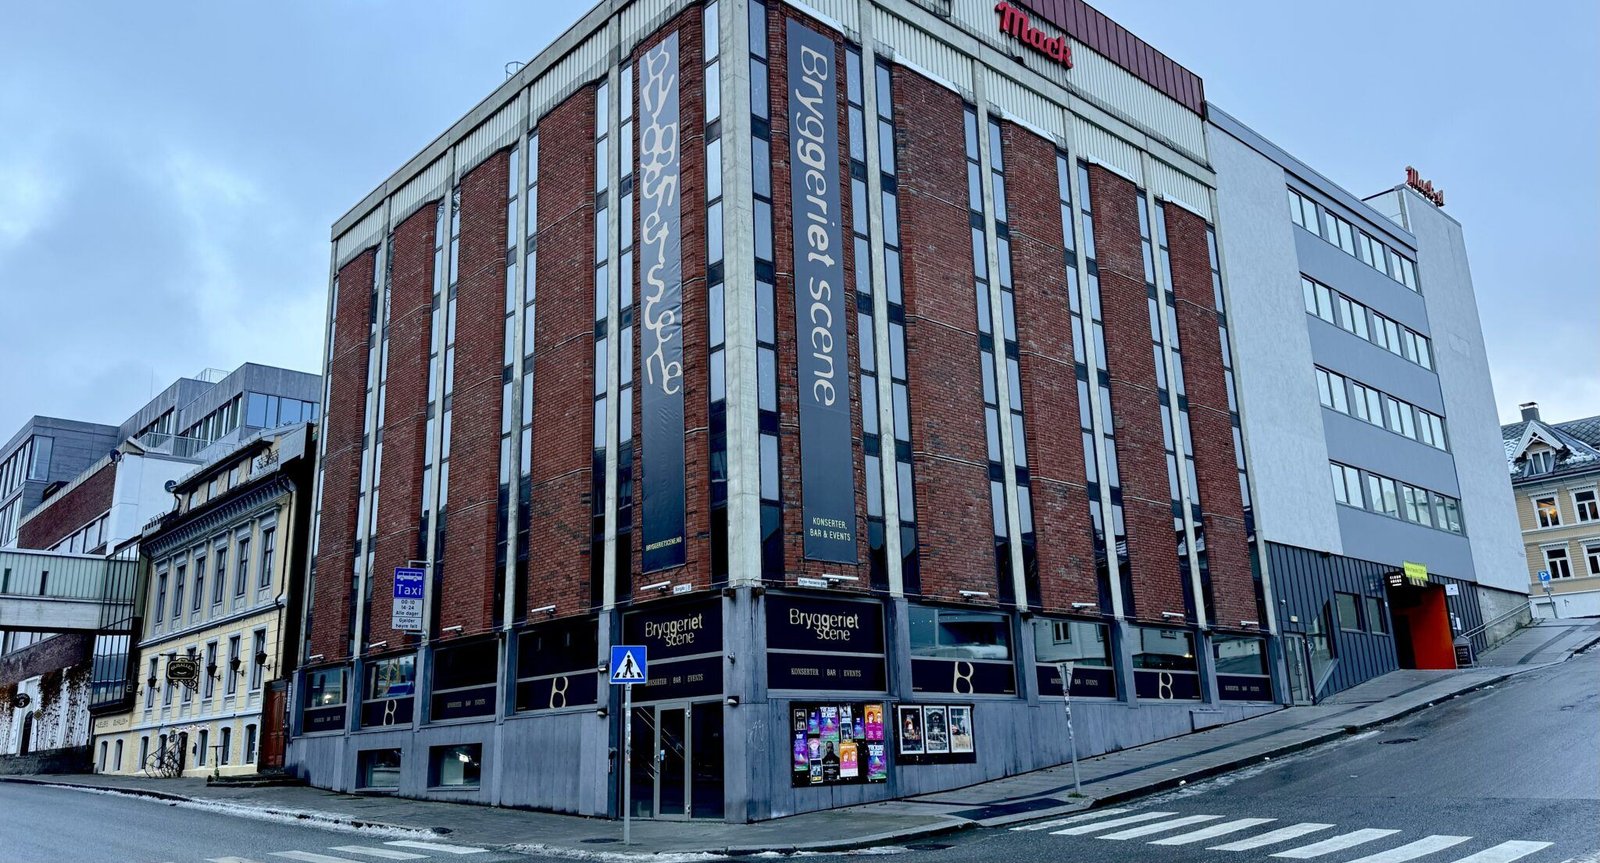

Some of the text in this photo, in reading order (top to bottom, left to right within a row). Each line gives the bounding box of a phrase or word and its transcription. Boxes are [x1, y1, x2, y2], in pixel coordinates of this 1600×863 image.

[994, 2, 1073, 69] Mack
[795, 45, 836, 406] Bryggeriet scene
[813, 517, 847, 530] KONSERTER,
[810, 528, 851, 542] BAR & EVENTS
[397, 584, 422, 596] Taxi
[645, 613, 703, 639] Bryggeriet
[789, 608, 859, 630] Bryggeriet
[666, 632, 694, 646] scene
[816, 628, 850, 641] scene
[790, 668, 819, 676] KONSERTER
